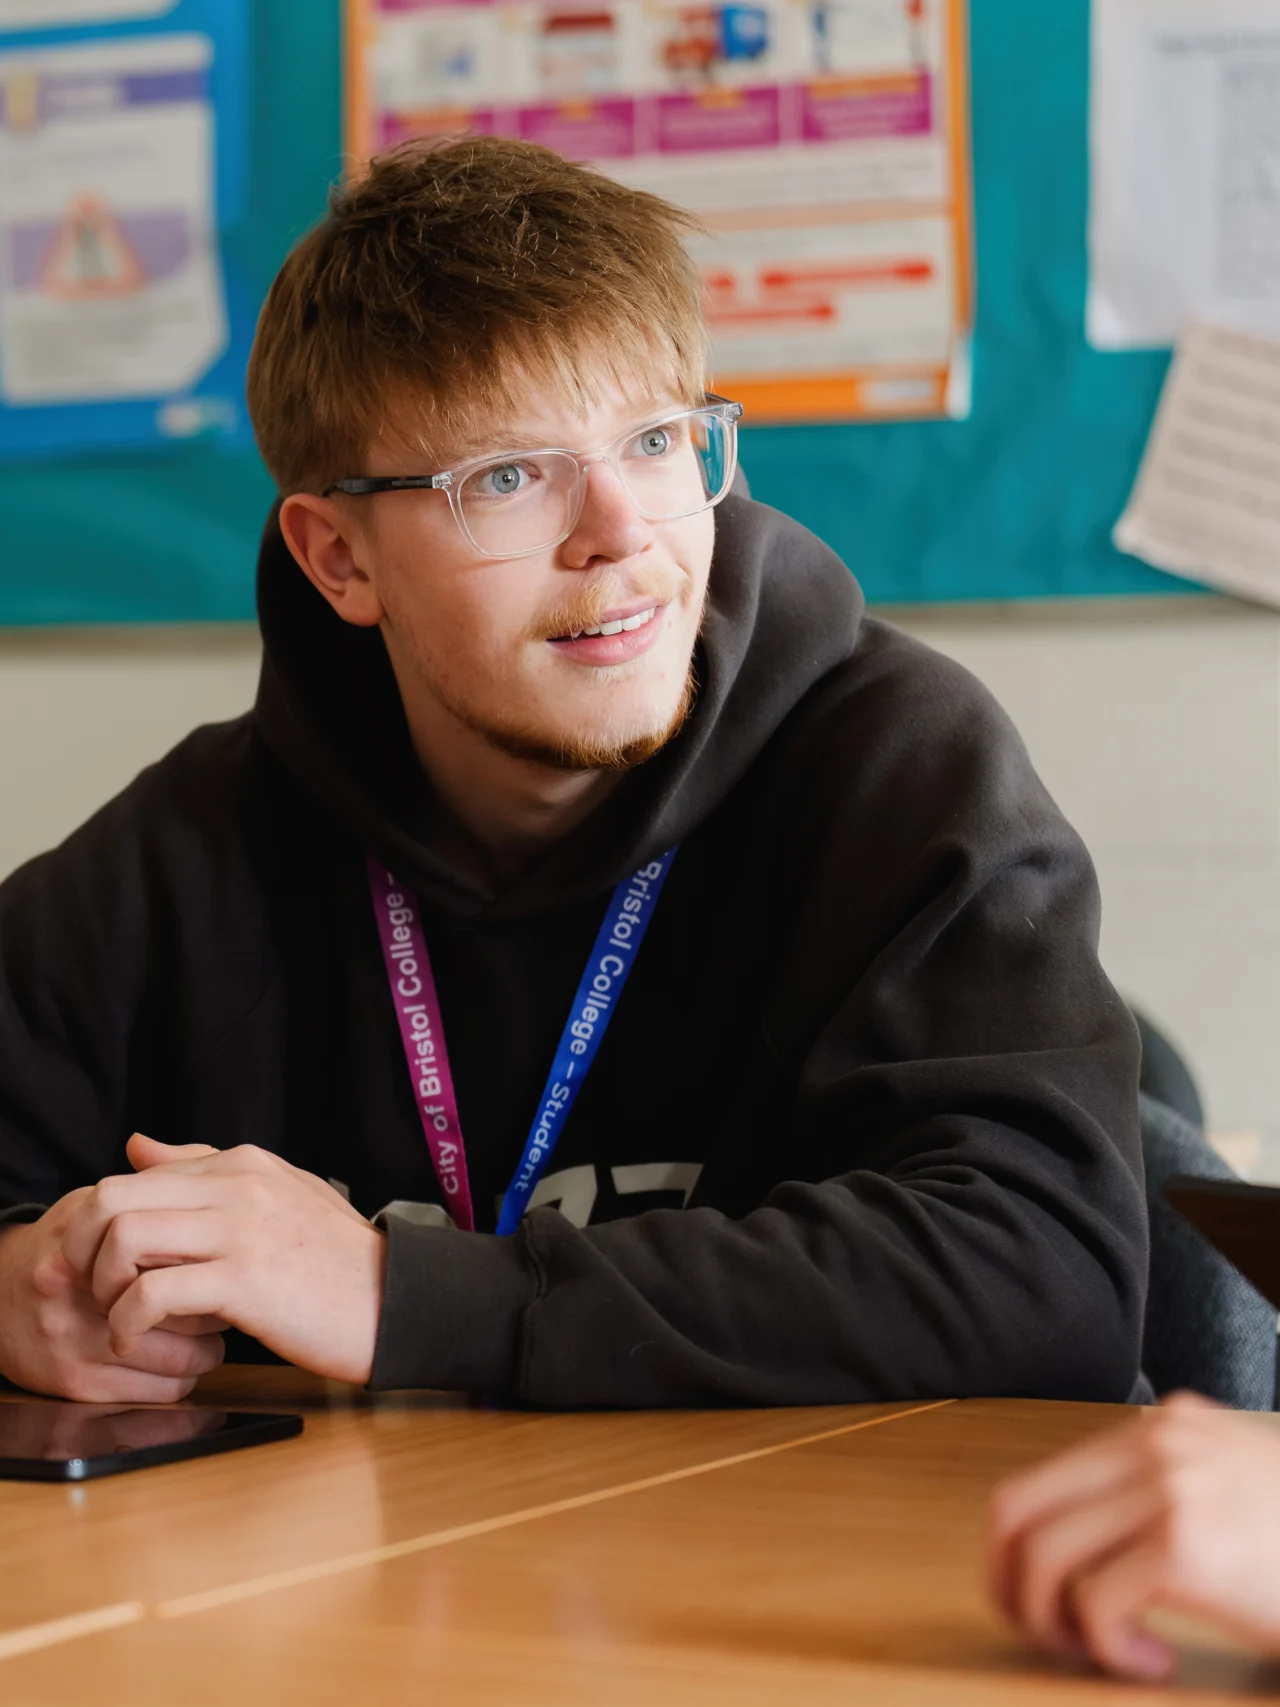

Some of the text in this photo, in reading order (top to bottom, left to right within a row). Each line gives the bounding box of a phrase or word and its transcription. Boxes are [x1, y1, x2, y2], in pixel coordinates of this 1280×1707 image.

[386, 892, 422, 997] College
[608, 860, 664, 951] Bristol
[403, 1003, 441, 1098] Bristol
[569, 953, 624, 1056] College
[424, 1105, 448, 1132] of
[515, 1081, 570, 1190] Student
[438, 1140, 458, 1194] City
